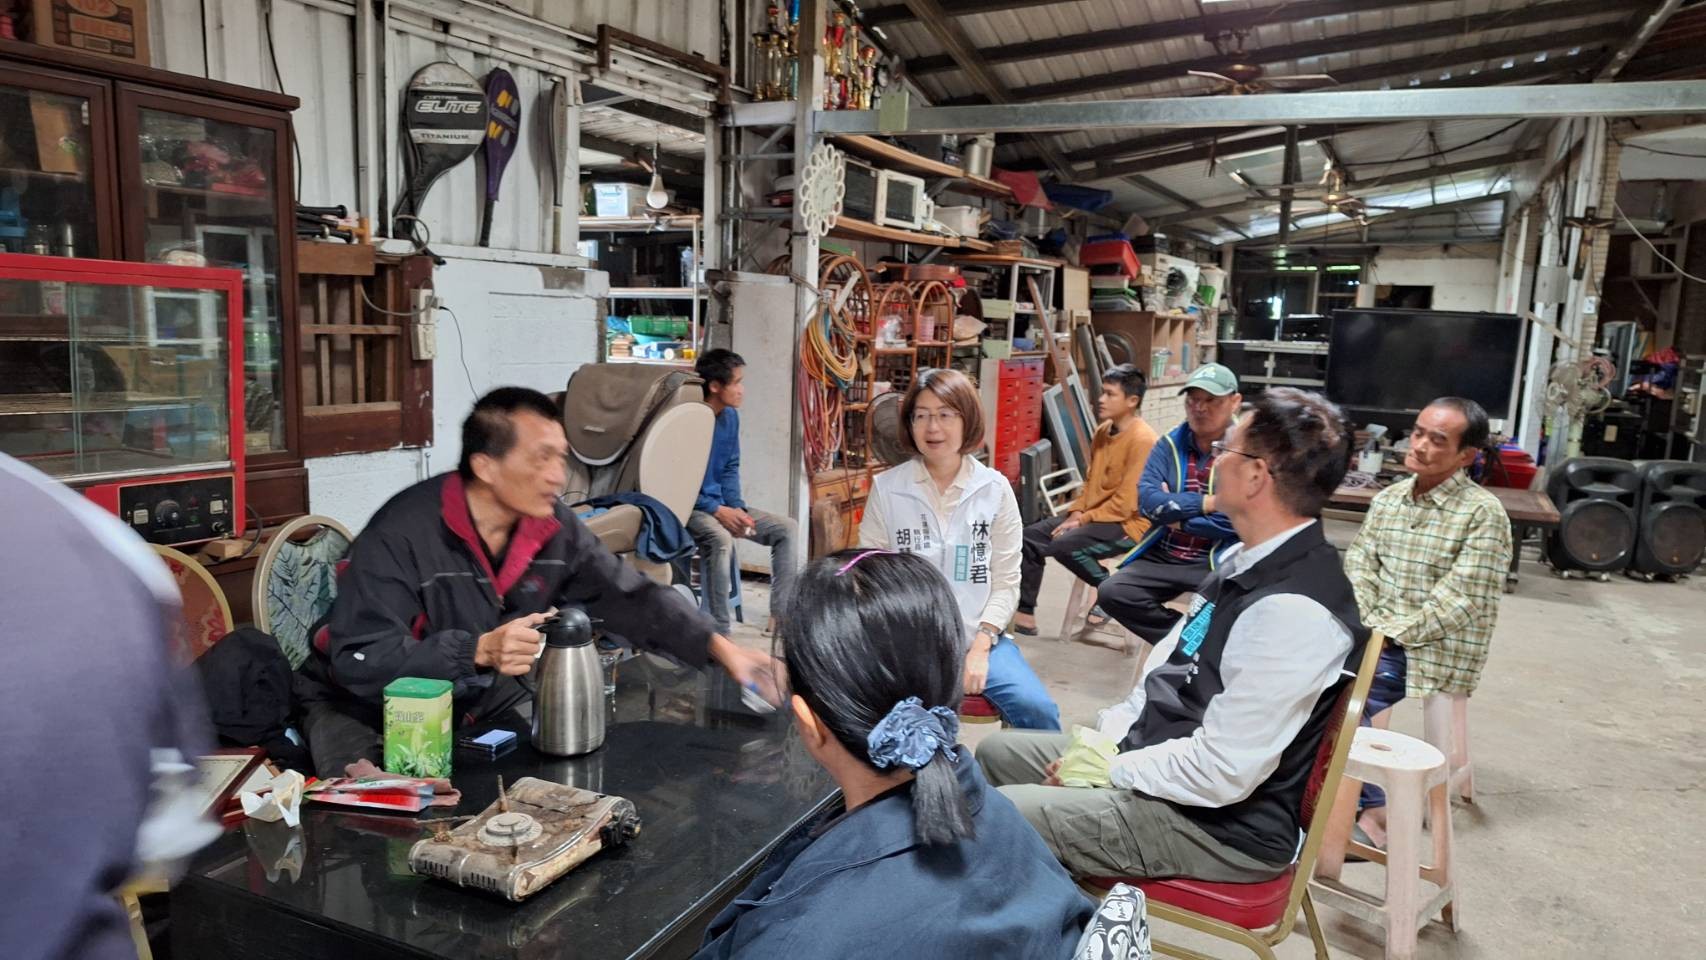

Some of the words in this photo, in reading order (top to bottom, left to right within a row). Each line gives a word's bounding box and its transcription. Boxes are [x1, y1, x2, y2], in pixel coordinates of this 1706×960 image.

[415, 100, 482, 113] ELITE
[971, 520, 988, 584] 林憶君
